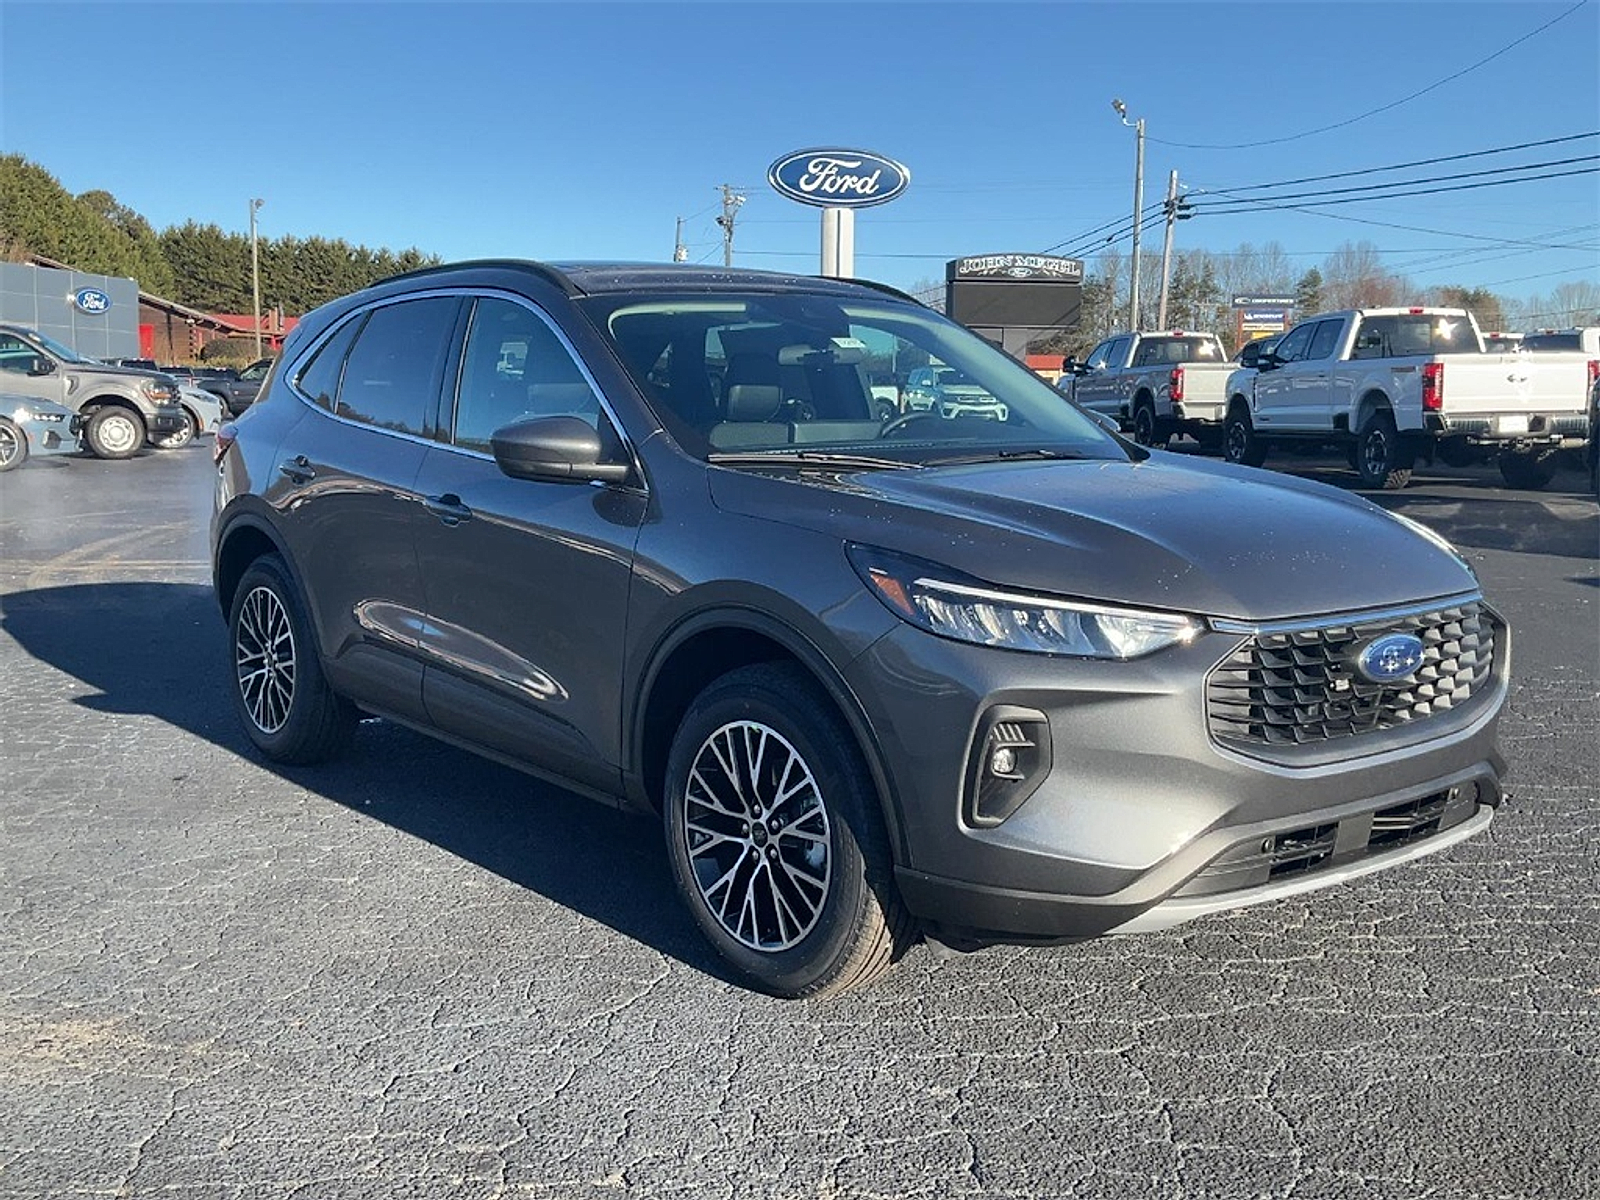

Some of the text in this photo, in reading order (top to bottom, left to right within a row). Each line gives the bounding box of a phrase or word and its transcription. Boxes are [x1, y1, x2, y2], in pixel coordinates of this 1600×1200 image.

[799, 157, 881, 194] Ford
[959, 255, 1014, 274] JOHN
[82, 292, 106, 310] Ford
